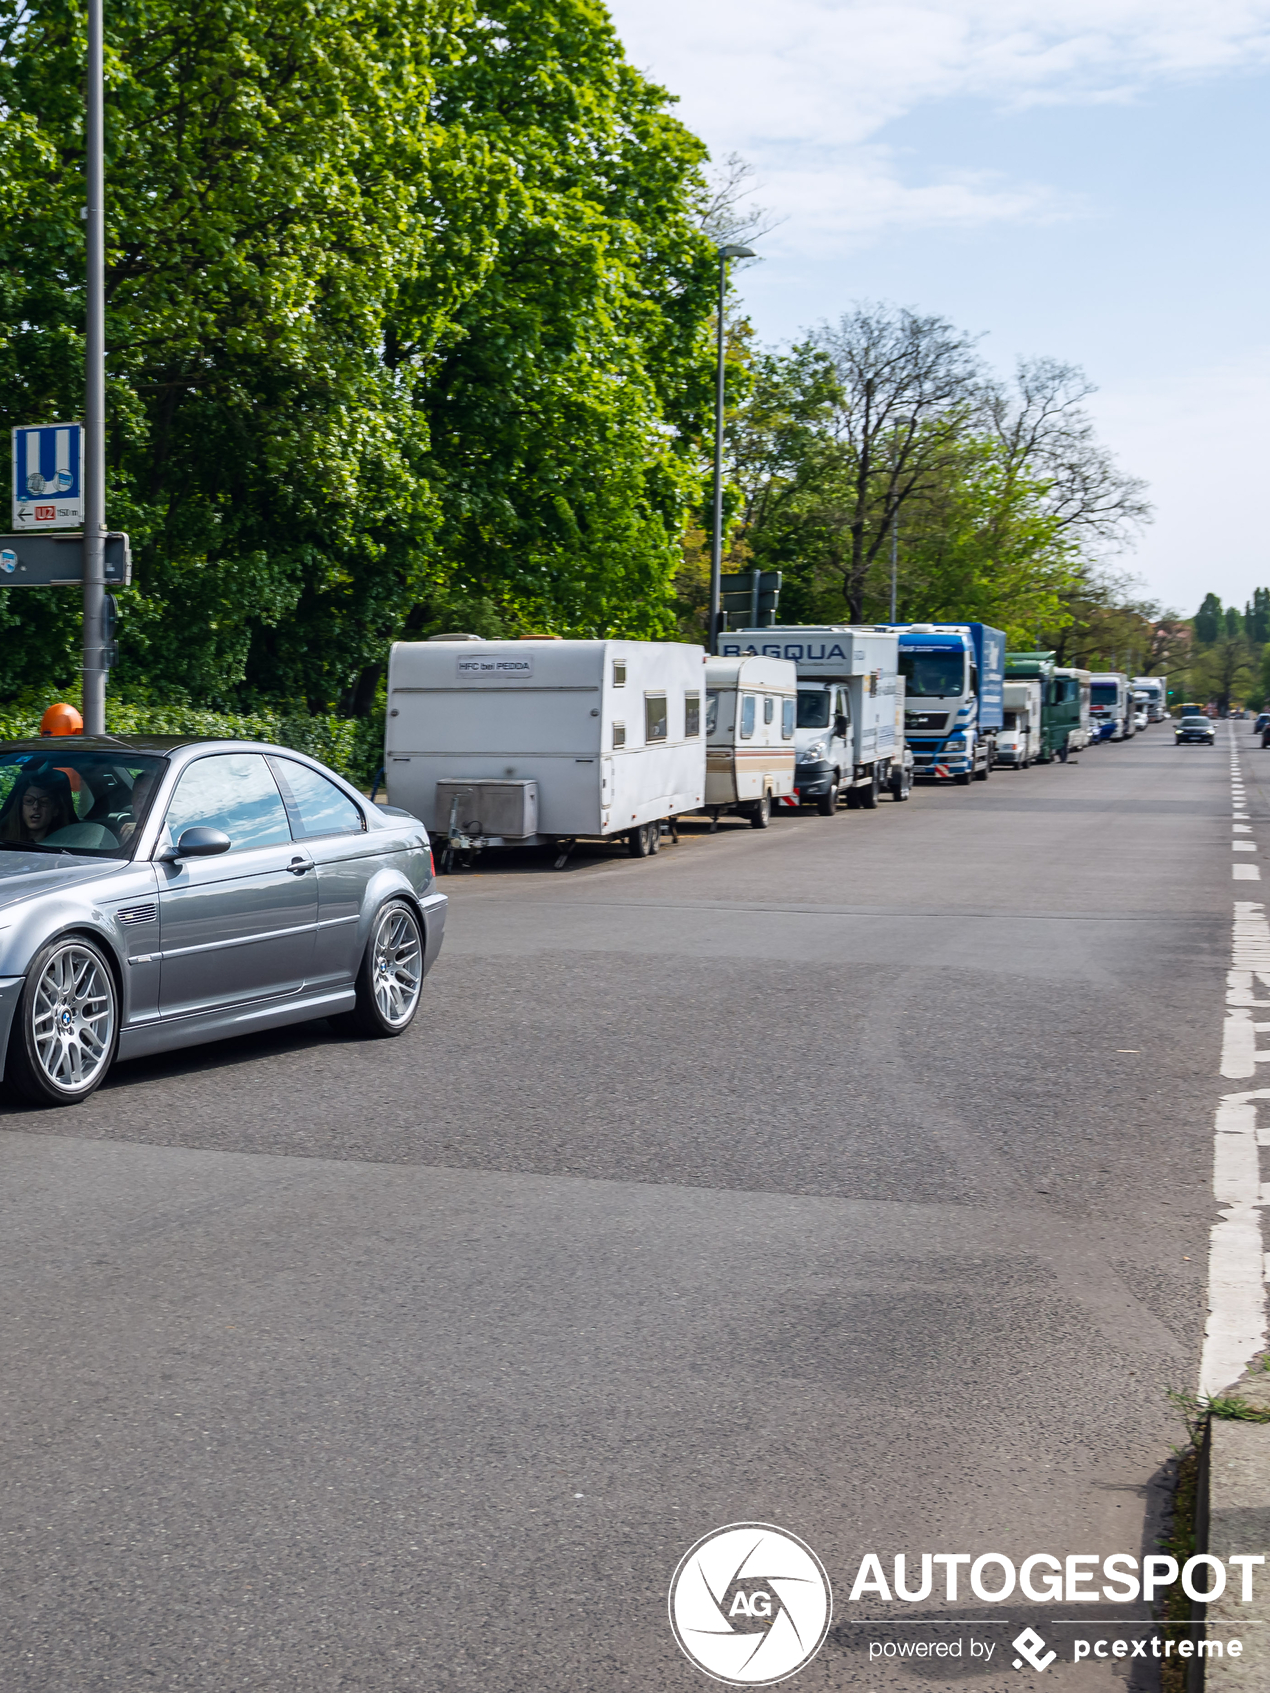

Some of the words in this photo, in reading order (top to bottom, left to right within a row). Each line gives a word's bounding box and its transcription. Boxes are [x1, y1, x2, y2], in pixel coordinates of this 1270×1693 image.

[26, 429, 71, 495] U
[36, 507, 54, 520] U2
[496, 662, 530, 671] PEDDA
